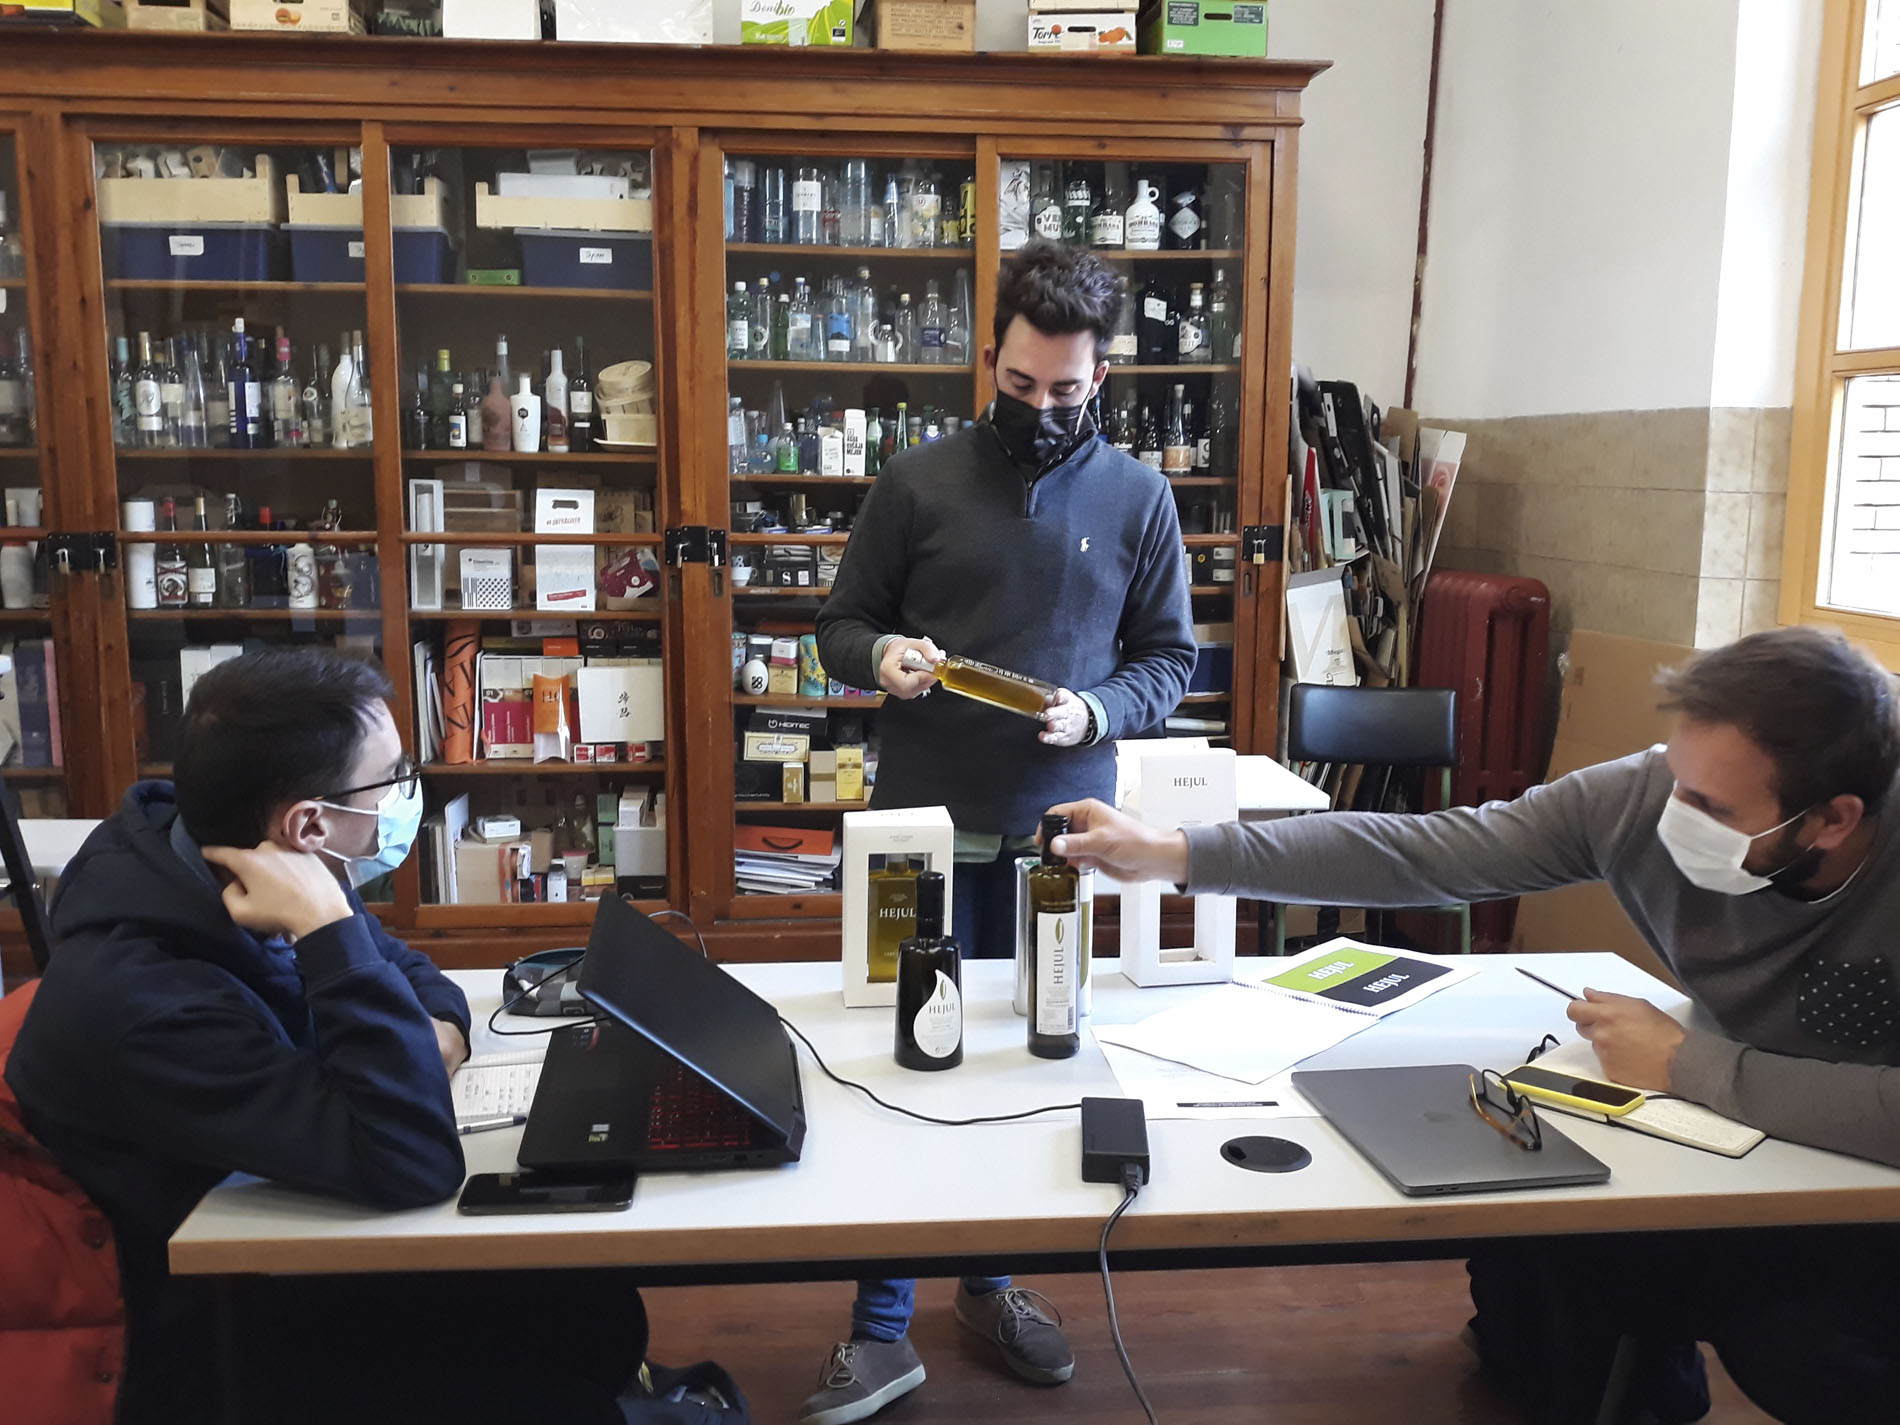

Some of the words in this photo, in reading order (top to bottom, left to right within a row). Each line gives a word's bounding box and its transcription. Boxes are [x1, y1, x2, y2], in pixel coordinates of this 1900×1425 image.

[1173, 777, 1208, 789] HEJUL
[879, 908, 917, 919] HEJUL
[1053, 946, 1065, 984] HEJUL
[928, 1003, 956, 1015] HEJUL
